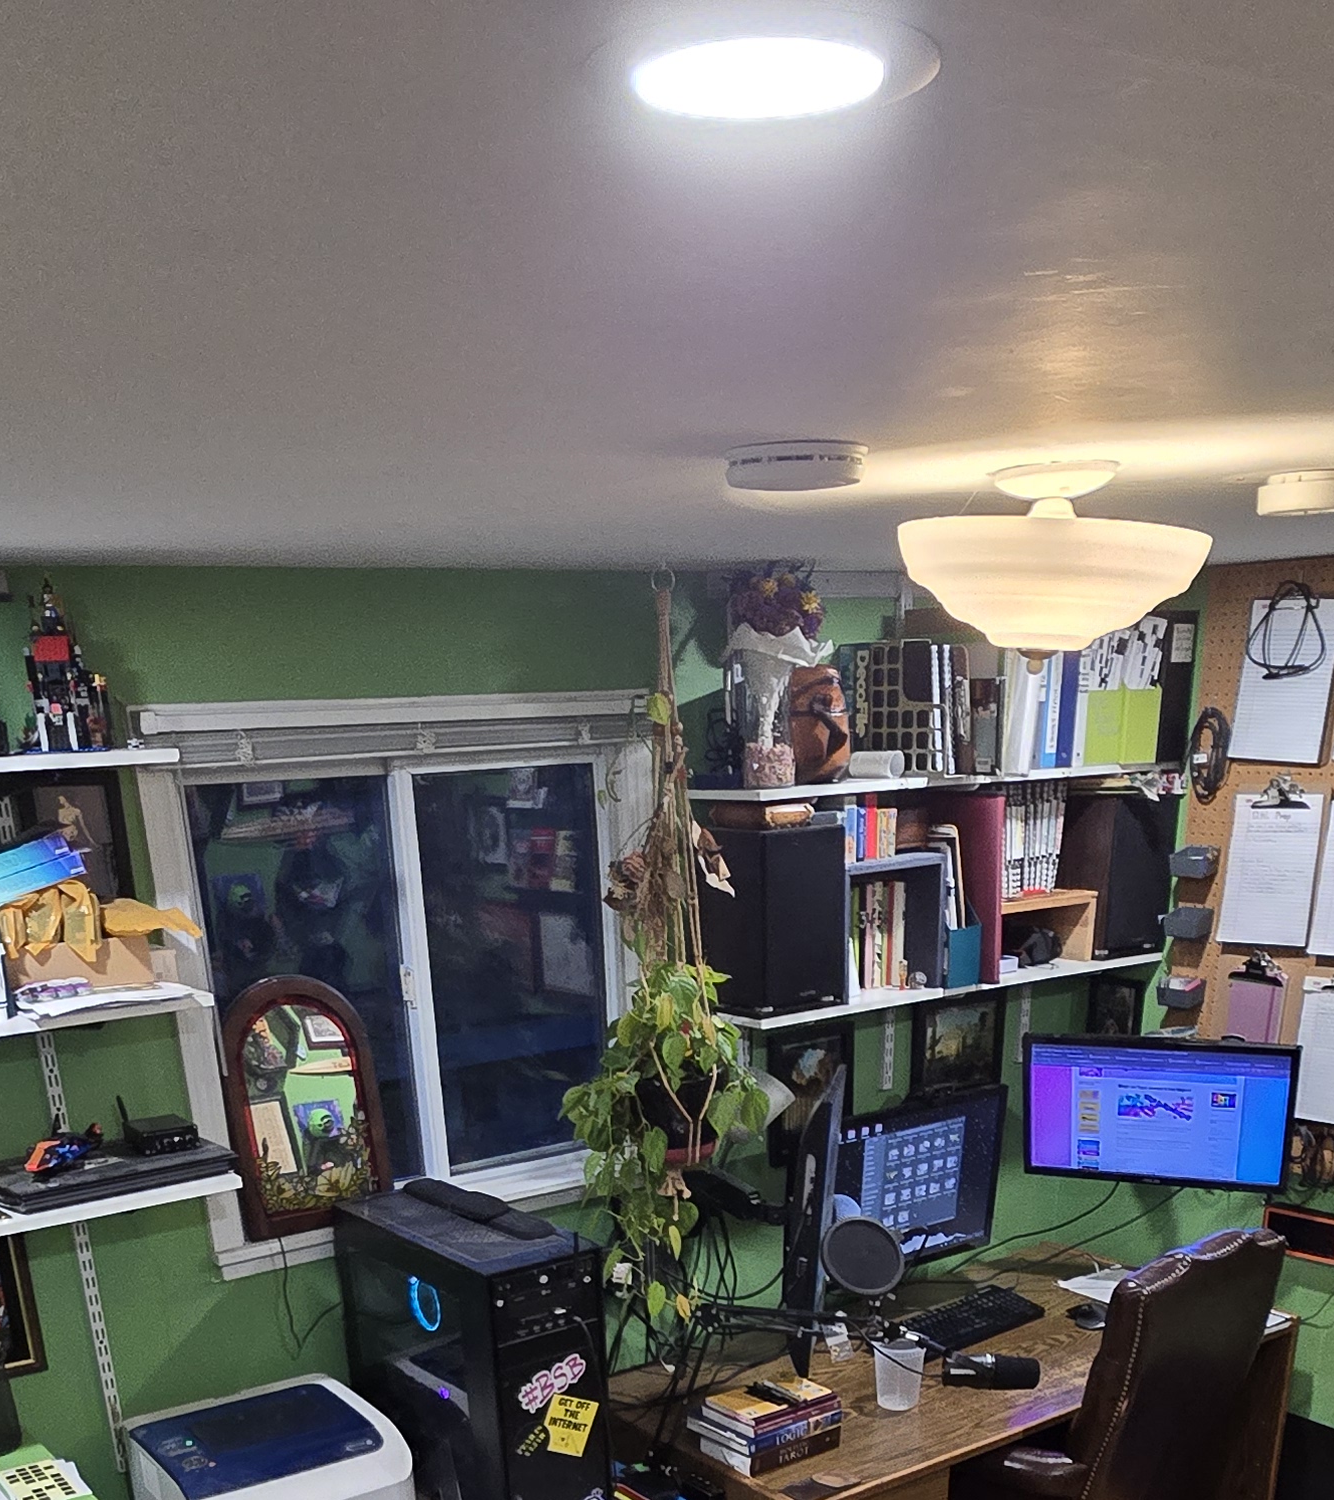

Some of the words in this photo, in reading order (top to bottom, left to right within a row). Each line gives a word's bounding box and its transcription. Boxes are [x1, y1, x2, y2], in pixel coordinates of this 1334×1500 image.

[522, 1357, 584, 1411] #BSB
[558, 1398, 574, 1407] GET
[576, 1401, 591, 1411] OFF
[564, 1409, 580, 1420] THE
[548, 1416, 588, 1433] INTERNET
[775, 1420, 808, 1446] LOGIC
[779, 1446, 809, 1464] TAROT
